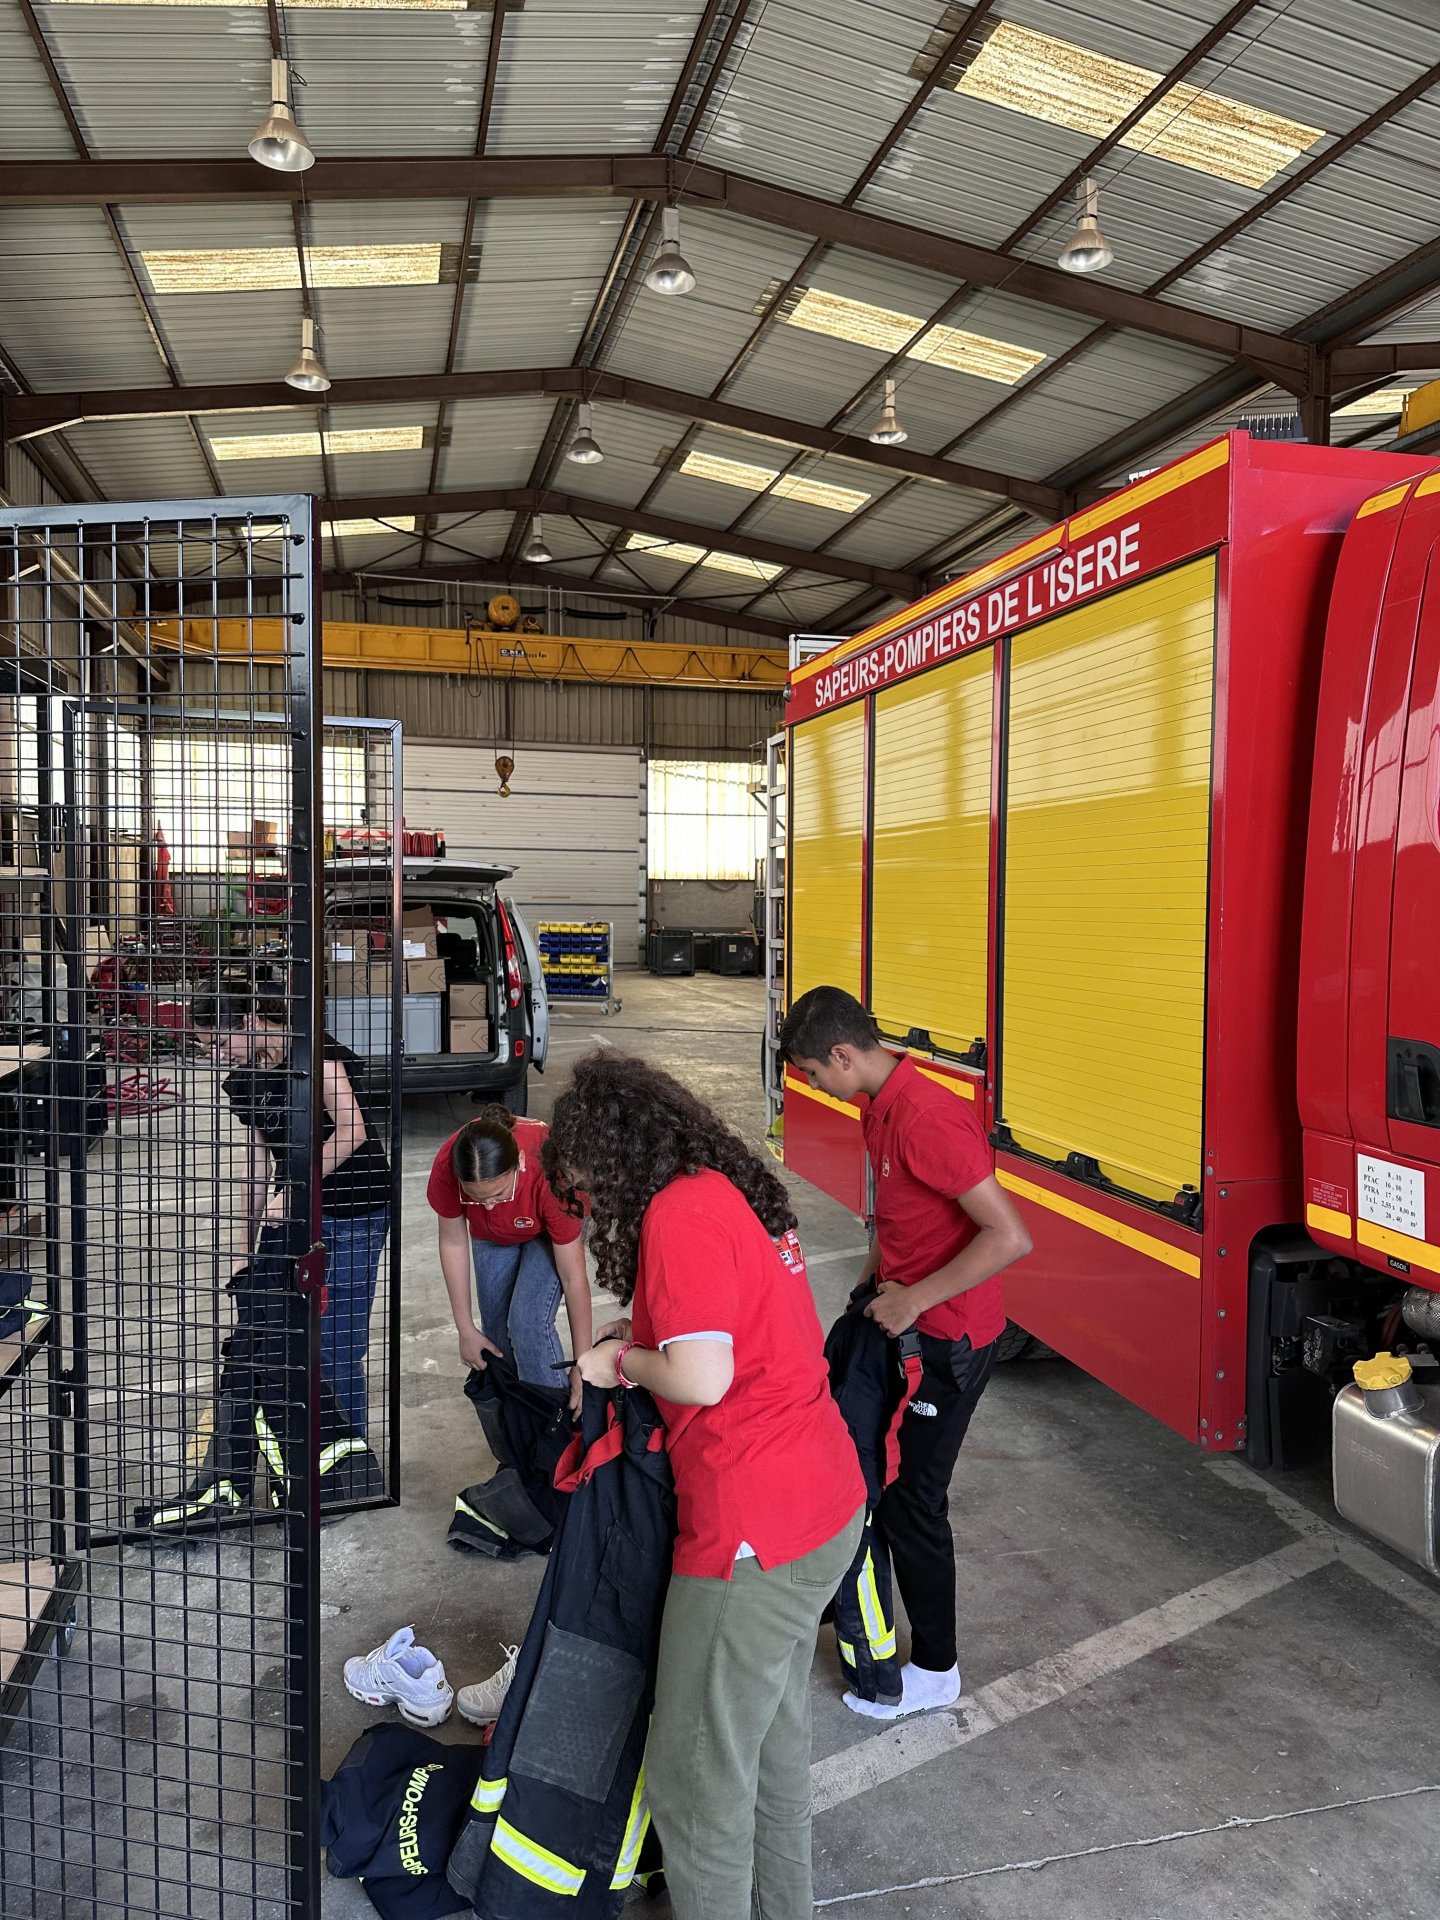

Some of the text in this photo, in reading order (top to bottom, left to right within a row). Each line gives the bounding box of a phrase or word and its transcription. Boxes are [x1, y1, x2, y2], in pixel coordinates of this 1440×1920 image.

[814, 522, 1141, 708] SAPEURS-POMPIERS DE L'ISERE
[1363, 1174, 1379, 1184] PTAC
[1363, 1184, 1379, 1195] PTRA
[1389, 1259, 1409, 1273] GASOIL
[1351, 1440, 1390, 1470] DIESEL
